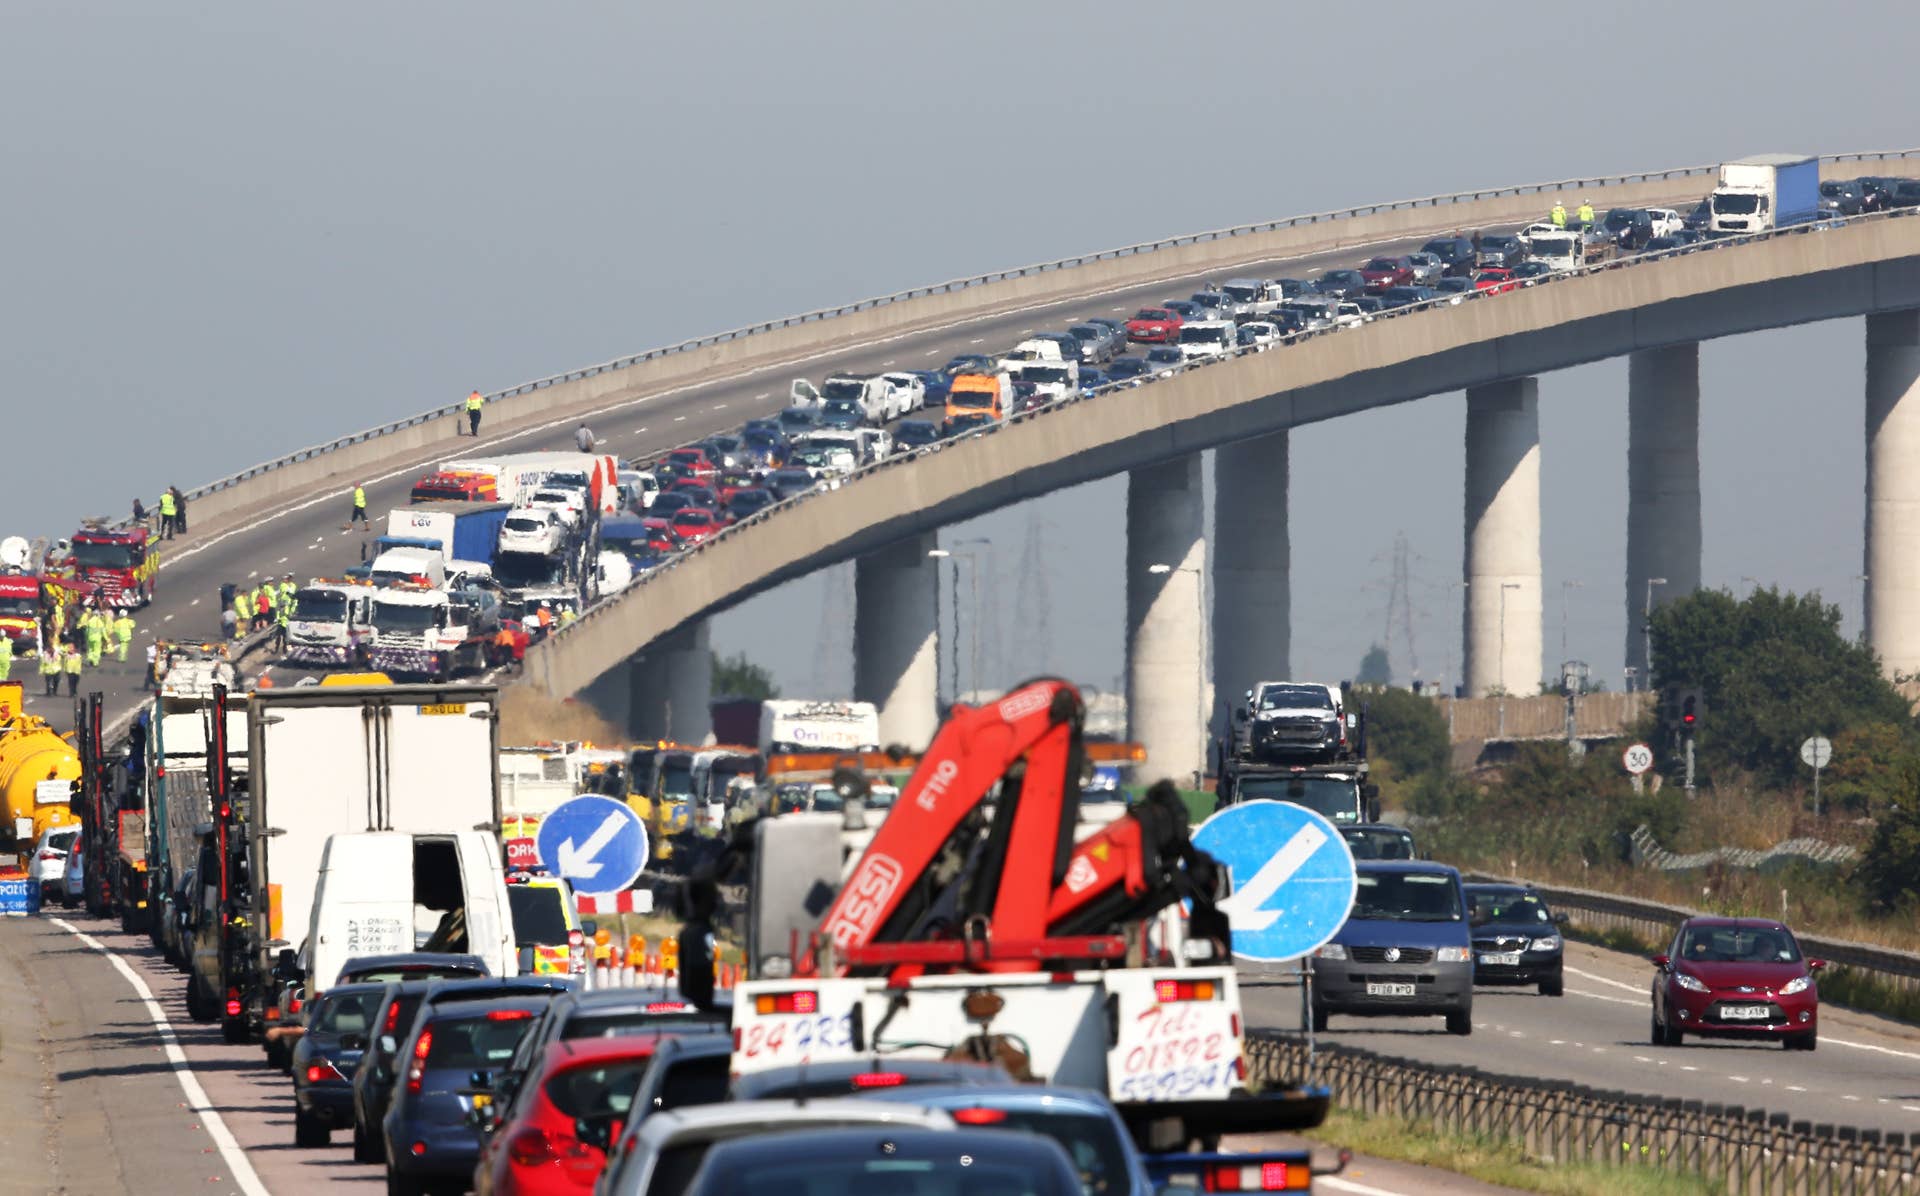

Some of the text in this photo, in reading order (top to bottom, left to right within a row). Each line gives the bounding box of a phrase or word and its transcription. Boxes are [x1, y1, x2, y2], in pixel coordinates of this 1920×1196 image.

[411, 519, 431, 527] LGV
[1630, 752, 1648, 767] 30
[745, 1022, 787, 1058] 24
[1124, 1033, 1222, 1074] 01892
